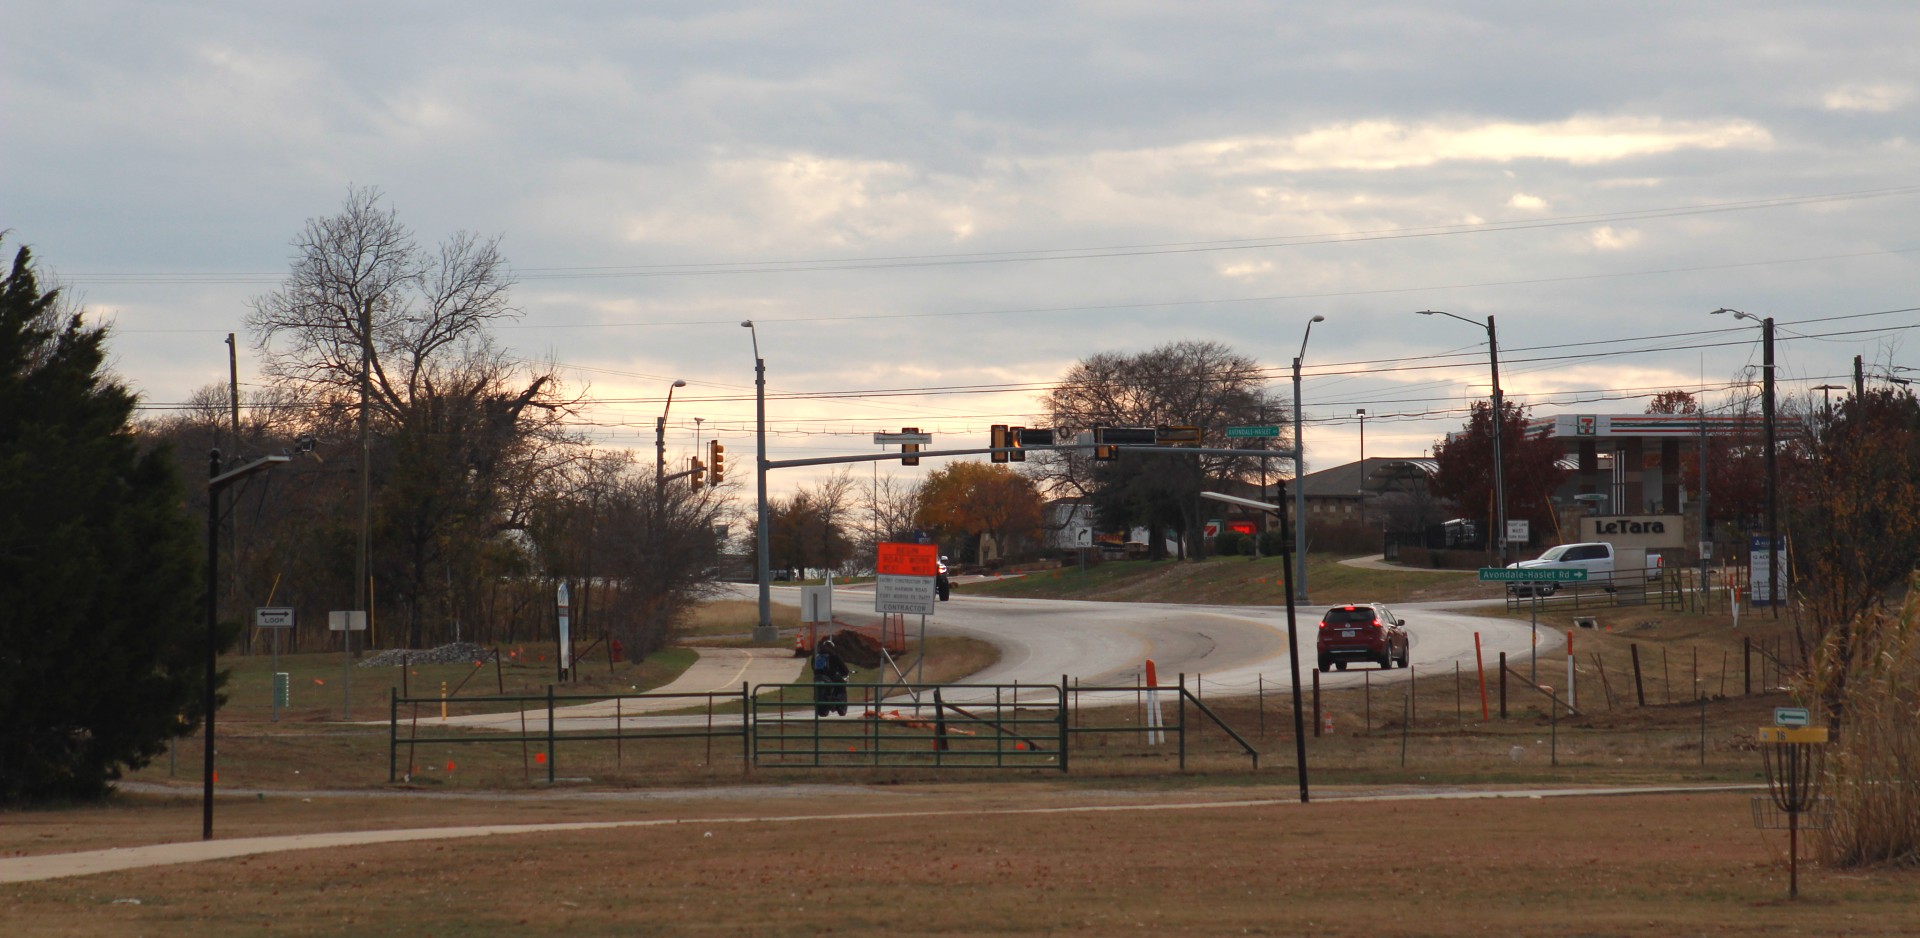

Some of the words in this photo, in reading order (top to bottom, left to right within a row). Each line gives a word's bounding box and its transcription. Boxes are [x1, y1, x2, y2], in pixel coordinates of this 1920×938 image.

[1595, 520, 1665, 534] LeTara
[1483, 570, 1555, 579] Avondale-Haslet
[1559, 570, 1570, 579] Rd
[883, 604, 926, 612] CONTRACTOR
